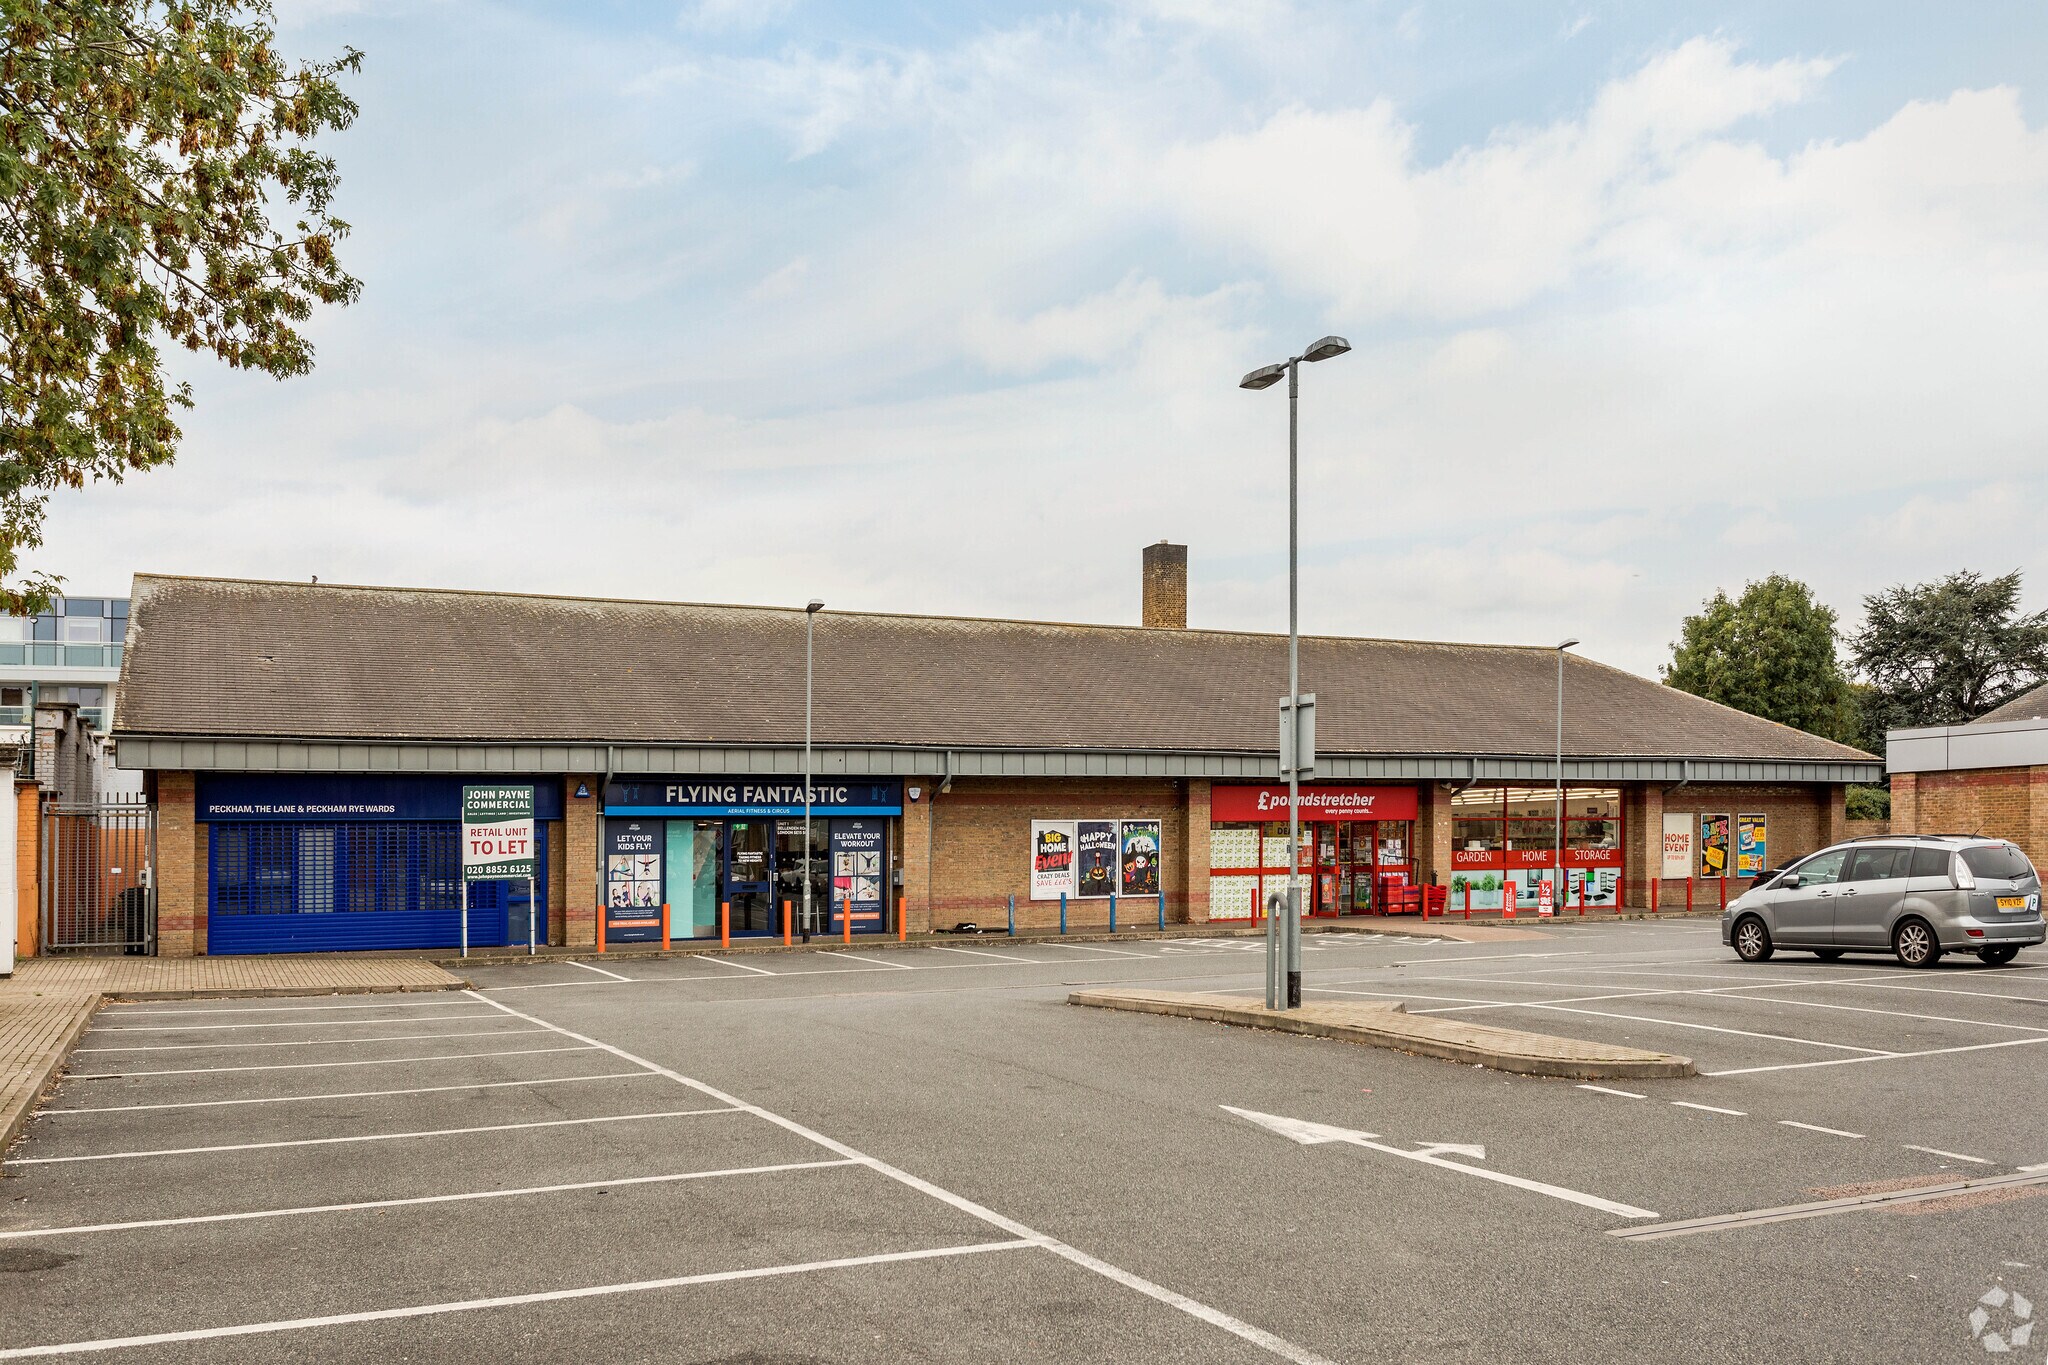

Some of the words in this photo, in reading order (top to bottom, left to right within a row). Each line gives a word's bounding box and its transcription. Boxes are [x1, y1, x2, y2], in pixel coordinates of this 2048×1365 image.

[467, 790, 496, 799] JOHN
[499, 790, 530, 799] PAYNE
[666, 785, 736, 803] FLYING
[743, 786, 848, 803] FANTASTIC
[467, 800, 531, 809] COMMERCIAL
[1270, 792, 1375, 809] pondstretcher
[209, 805, 254, 814] PECKHAM,
[255, 805, 271, 813] THE
[273, 805, 296, 813] LANE
[297, 805, 304, 813] &
[306, 805, 347, 813] PECKHAM
[348, 805, 364, 813] RYE
[365, 805, 395, 813] WARDS
[470, 828, 503, 837] RETAIL
[505, 828, 528, 836] UNIT
[1702, 820, 1728, 839] BACK
[1045, 833, 1062, 843] BIG
[1084, 832, 1113, 842] HAPPY
[1664, 833, 1690, 843] HOME
[470, 840, 494, 855] TO
[498, 840, 528, 854] LET
[1040, 843, 1067, 853] HOME
[1080, 842, 1116, 852] HALLOWEEN
[1664, 843, 1690, 852] EVENT
[1456, 851, 1492, 862] GARDEN
[1521, 851, 1547, 861] HOME
[1574, 850, 1611, 860] STORAGE
[1034, 851, 1073, 871] Event
[467, 866, 484, 874] 020
[2032, 898, 2036, 907] P
